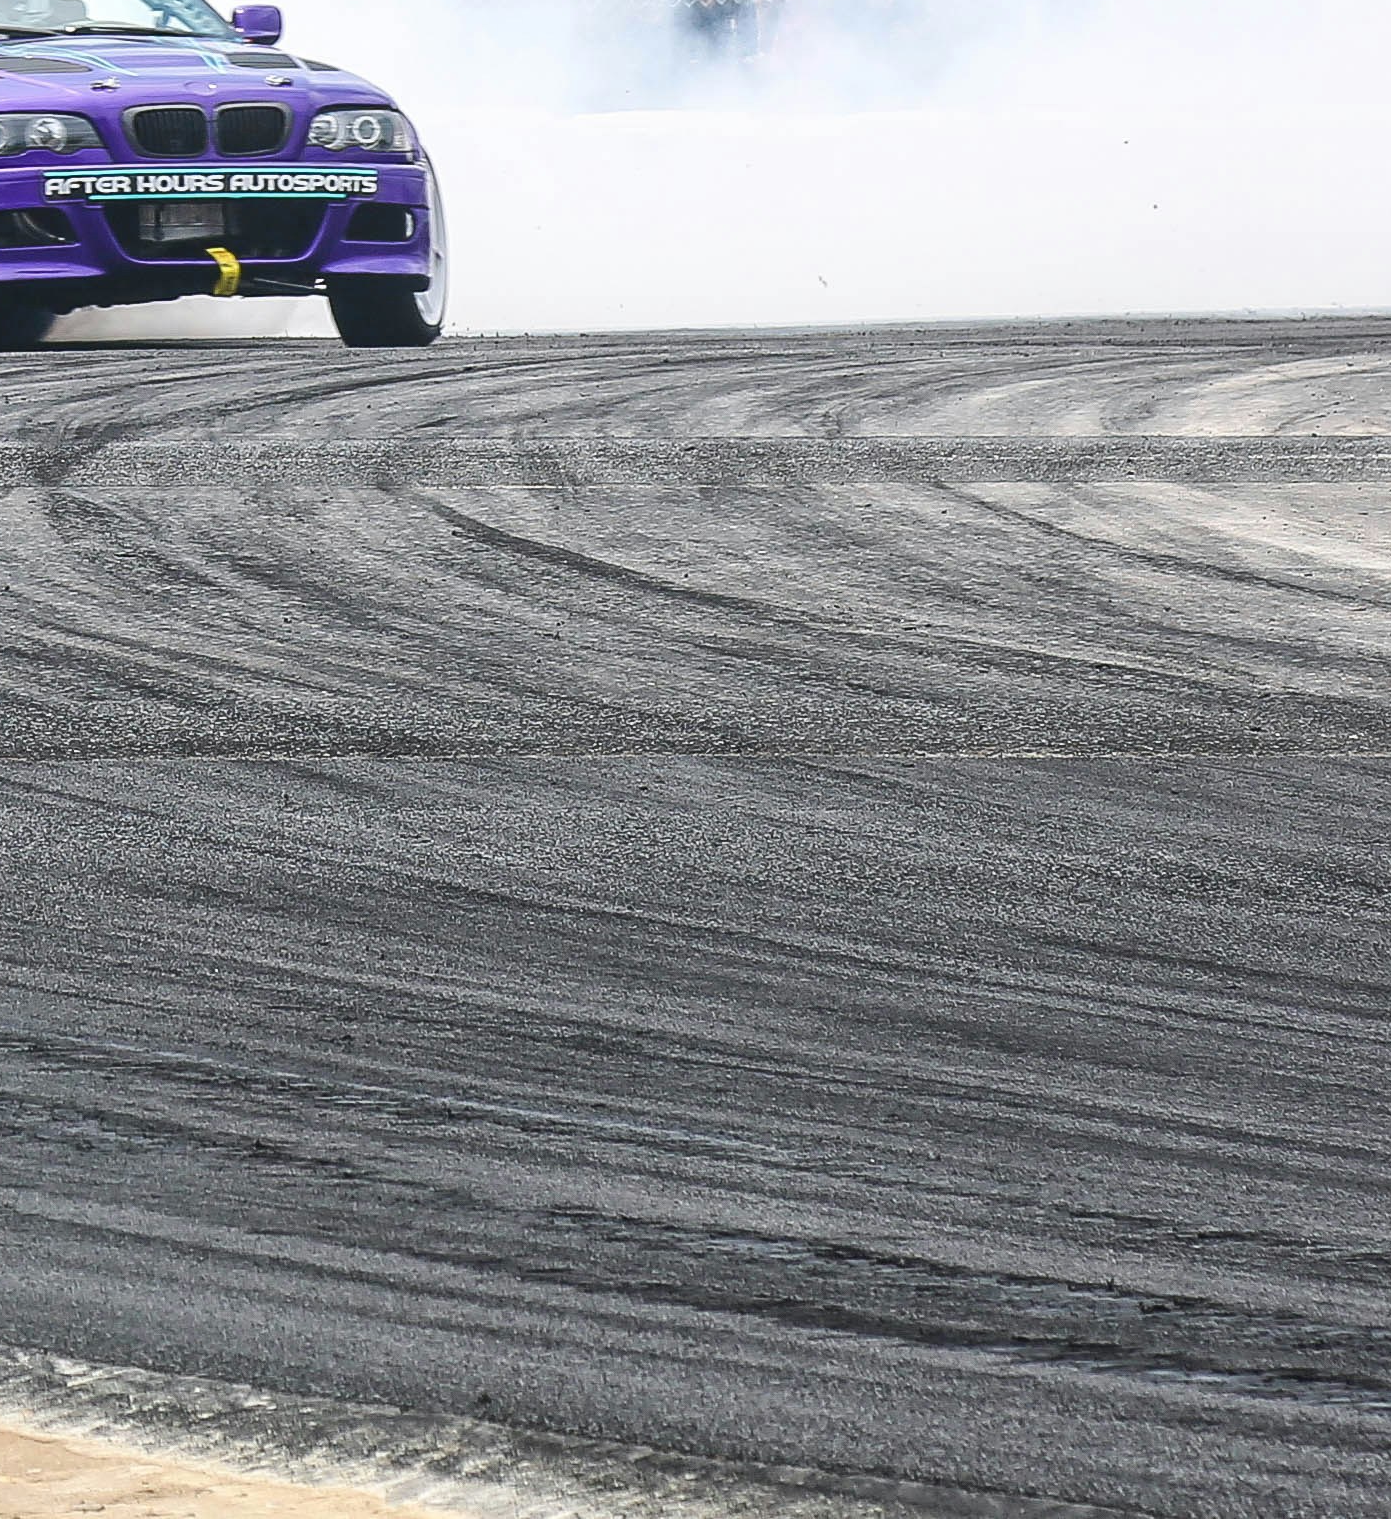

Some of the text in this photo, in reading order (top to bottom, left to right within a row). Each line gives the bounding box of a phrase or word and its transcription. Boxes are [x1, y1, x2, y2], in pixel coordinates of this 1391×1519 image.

[44, 174, 377, 196] AFTER HOURS AUTOSPORTS
